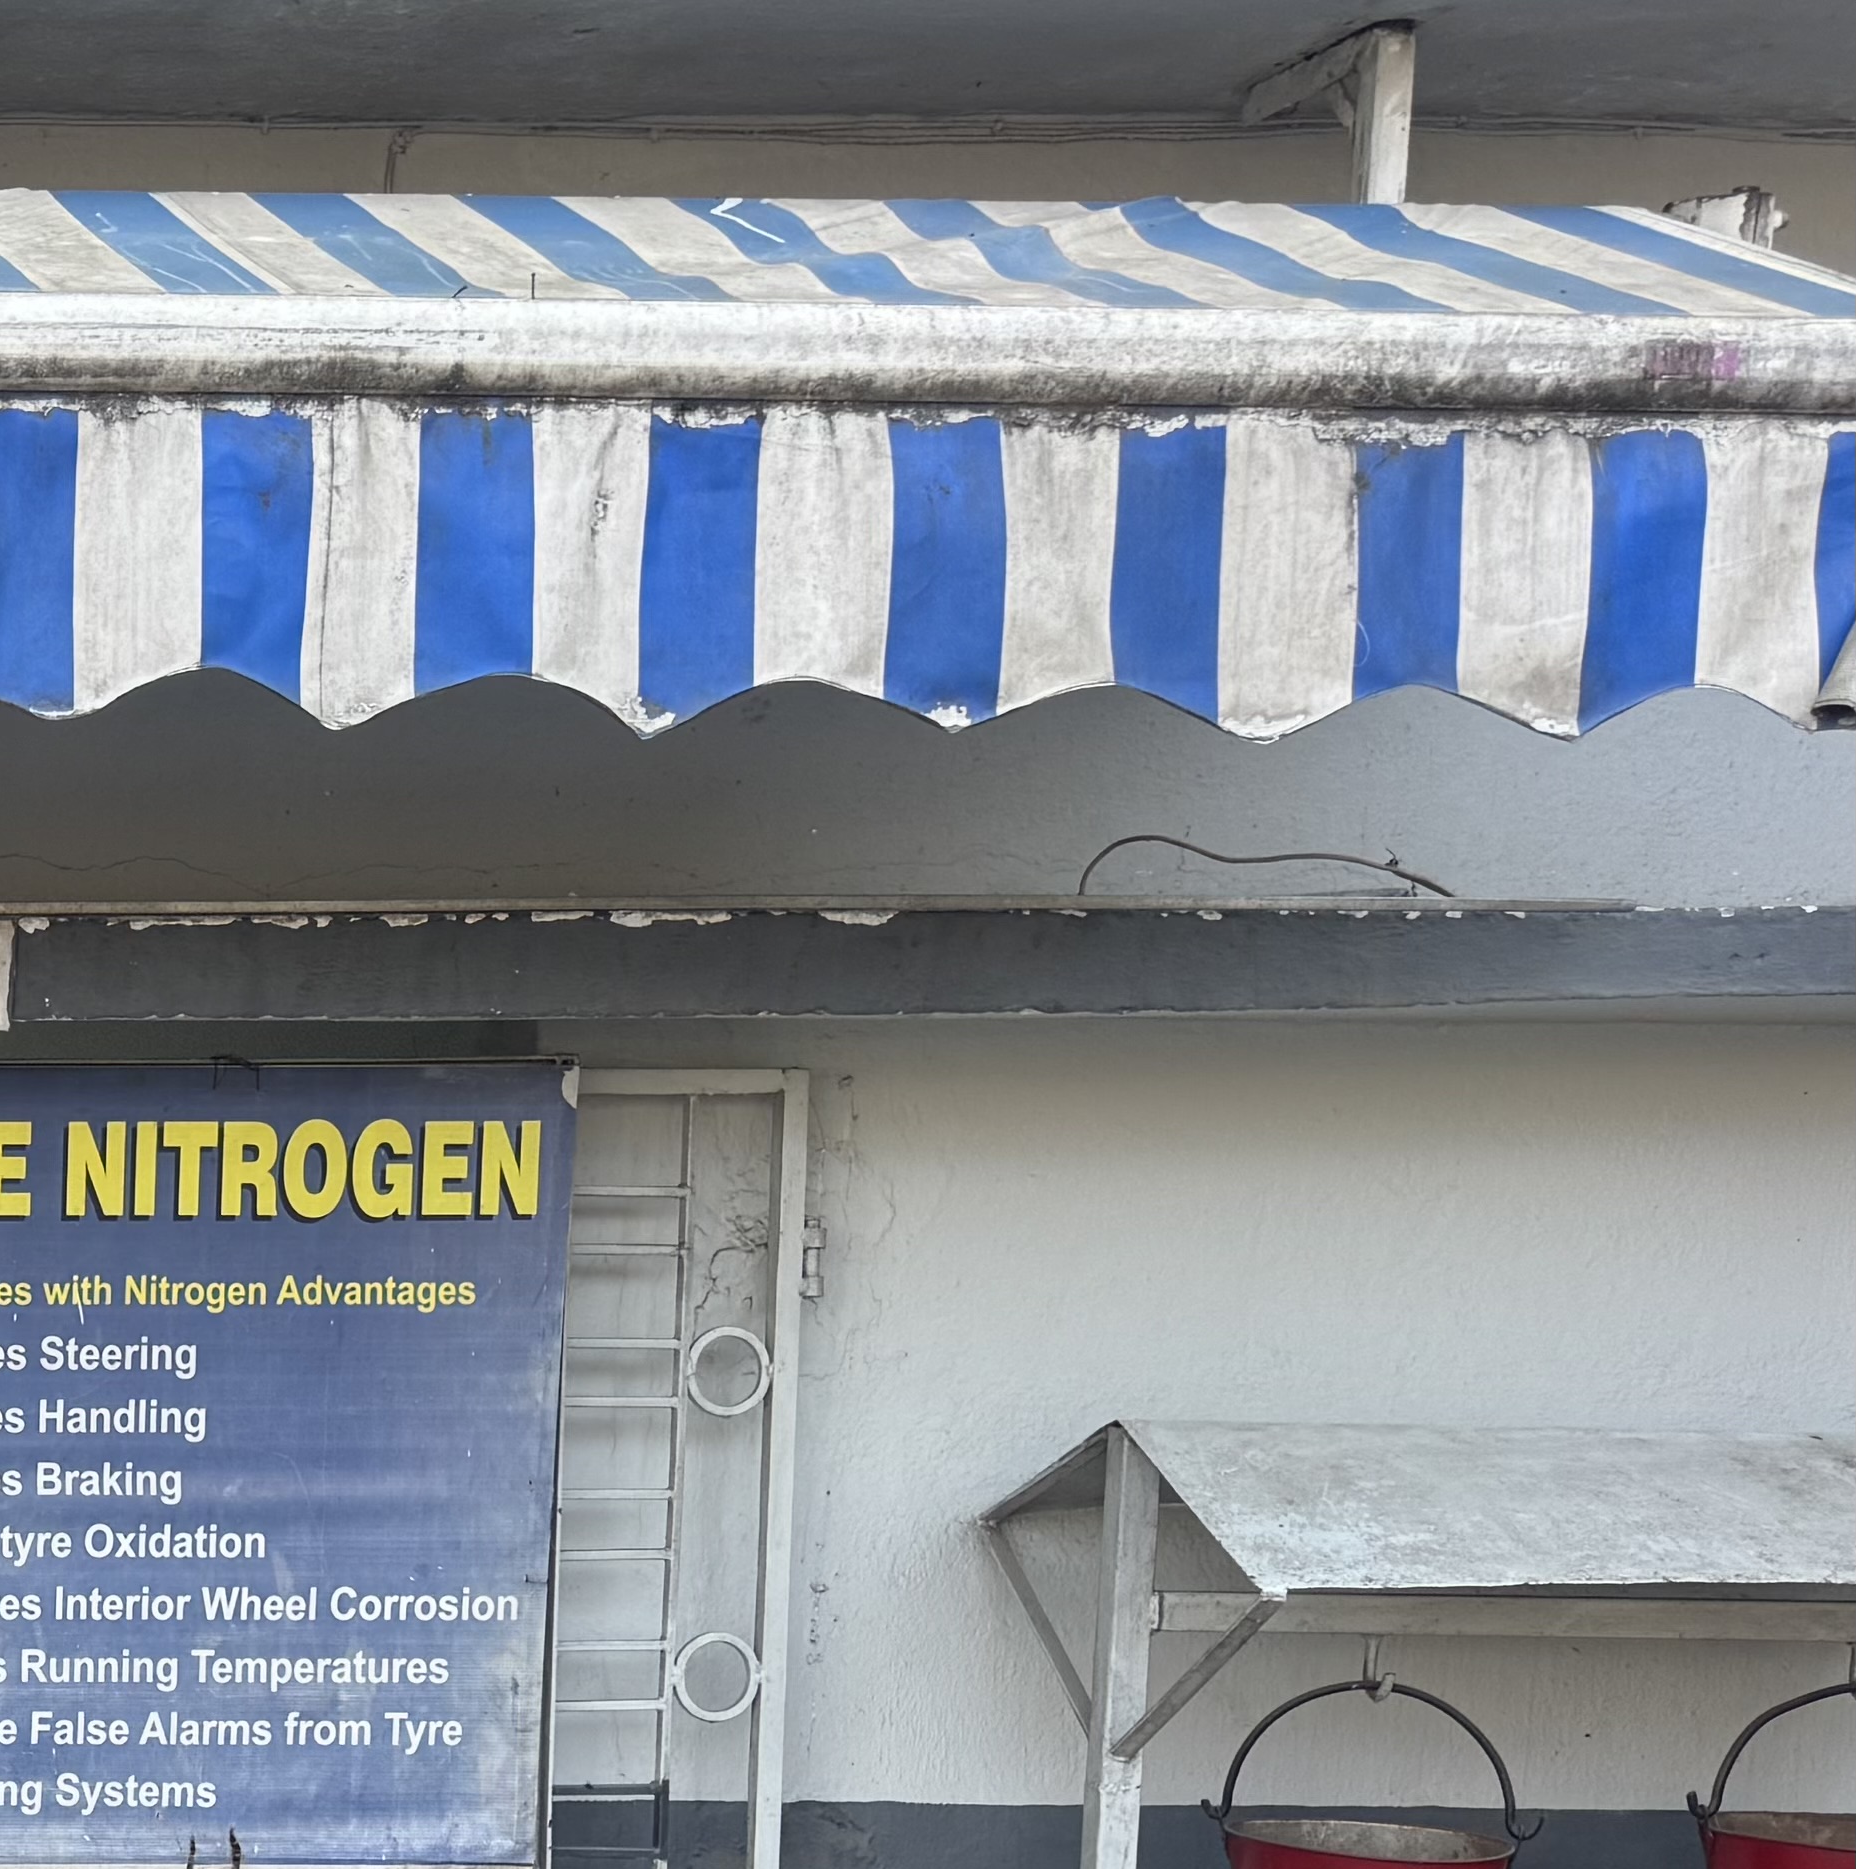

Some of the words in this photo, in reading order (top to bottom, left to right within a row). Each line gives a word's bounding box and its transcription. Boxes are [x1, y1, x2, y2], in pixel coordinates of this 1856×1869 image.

[65, 1118, 542, 1220] NITROGEN
[44, 1275, 112, 1307] with
[124, 1275, 267, 1313] Nitrogen
[276, 1275, 476, 1313] Advantages
[39, 1336, 198, 1379] Steering
[39, 1399, 206, 1443] Handling
[36, 1461, 183, 1505] Braking
[0, 1525, 72, 1566] tyre
[84, 1524, 266, 1559] Oxidation
[55, 1586, 192, 1621] Interior
[201, 1586, 317, 1621] Wheel
[330, 1586, 519, 1621] Corrosion
[21, 1648, 179, 1690] Running
[191, 1649, 449, 1690] Temperatures
[30, 1711, 130, 1746] False
[139, 1711, 272, 1746] Alarms
[284, 1711, 372, 1746] from
[384, 1712, 464, 1755] Tyre
[55, 1772, 218, 1815] Systems
